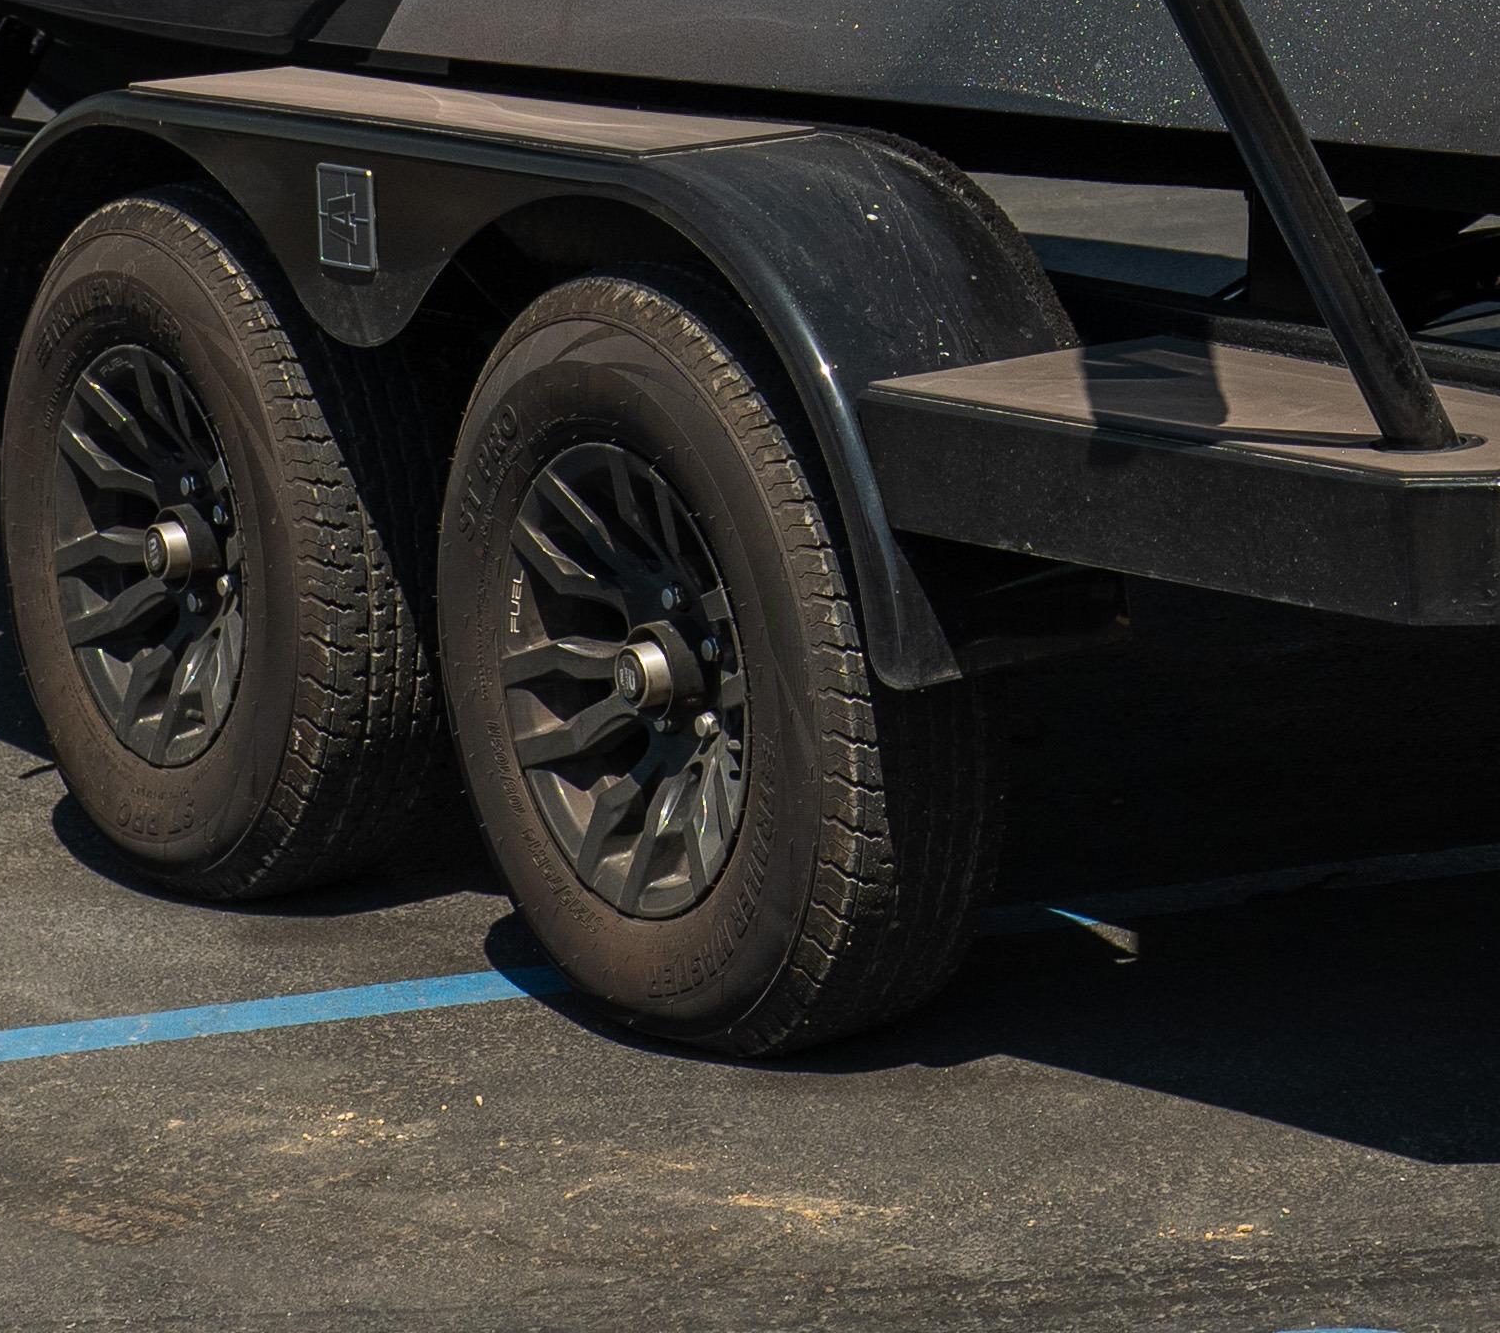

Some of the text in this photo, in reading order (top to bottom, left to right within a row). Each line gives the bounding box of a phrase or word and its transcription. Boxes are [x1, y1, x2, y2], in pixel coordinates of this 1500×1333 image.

[99, 356, 135, 378] FUEL
[477, 404, 518, 483] PRO
[509, 570, 525, 634] FUEL
